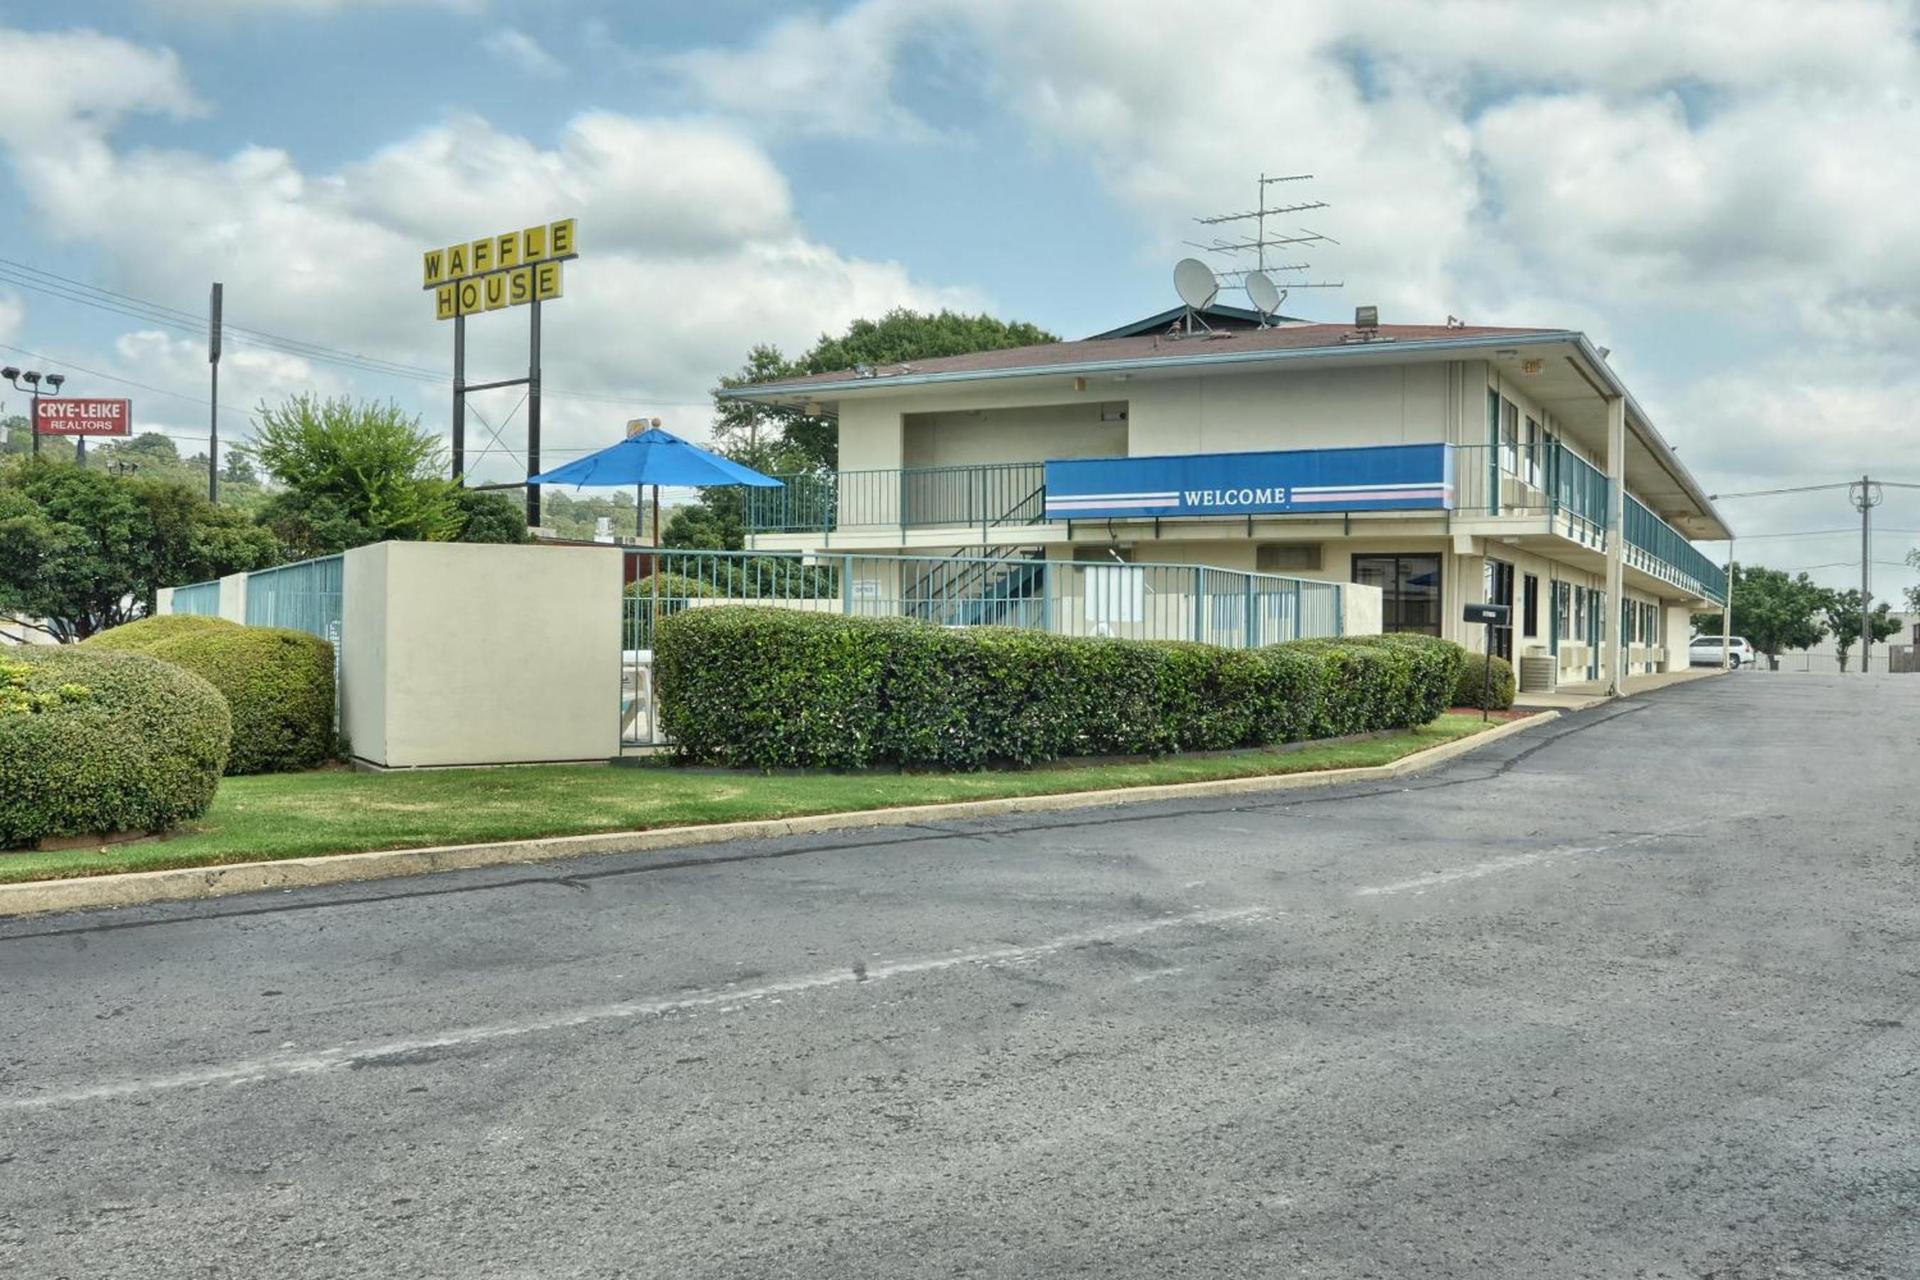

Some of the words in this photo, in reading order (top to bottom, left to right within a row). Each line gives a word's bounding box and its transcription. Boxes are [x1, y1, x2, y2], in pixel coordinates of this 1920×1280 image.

[425, 225, 568, 280] WAFFLE
[438, 268, 553, 314] HOUSE
[38, 403, 120, 418] CRYE-LEIKE
[50, 420, 113, 430] REALTORS
[1184, 488, 1286, 507] WELCOME
